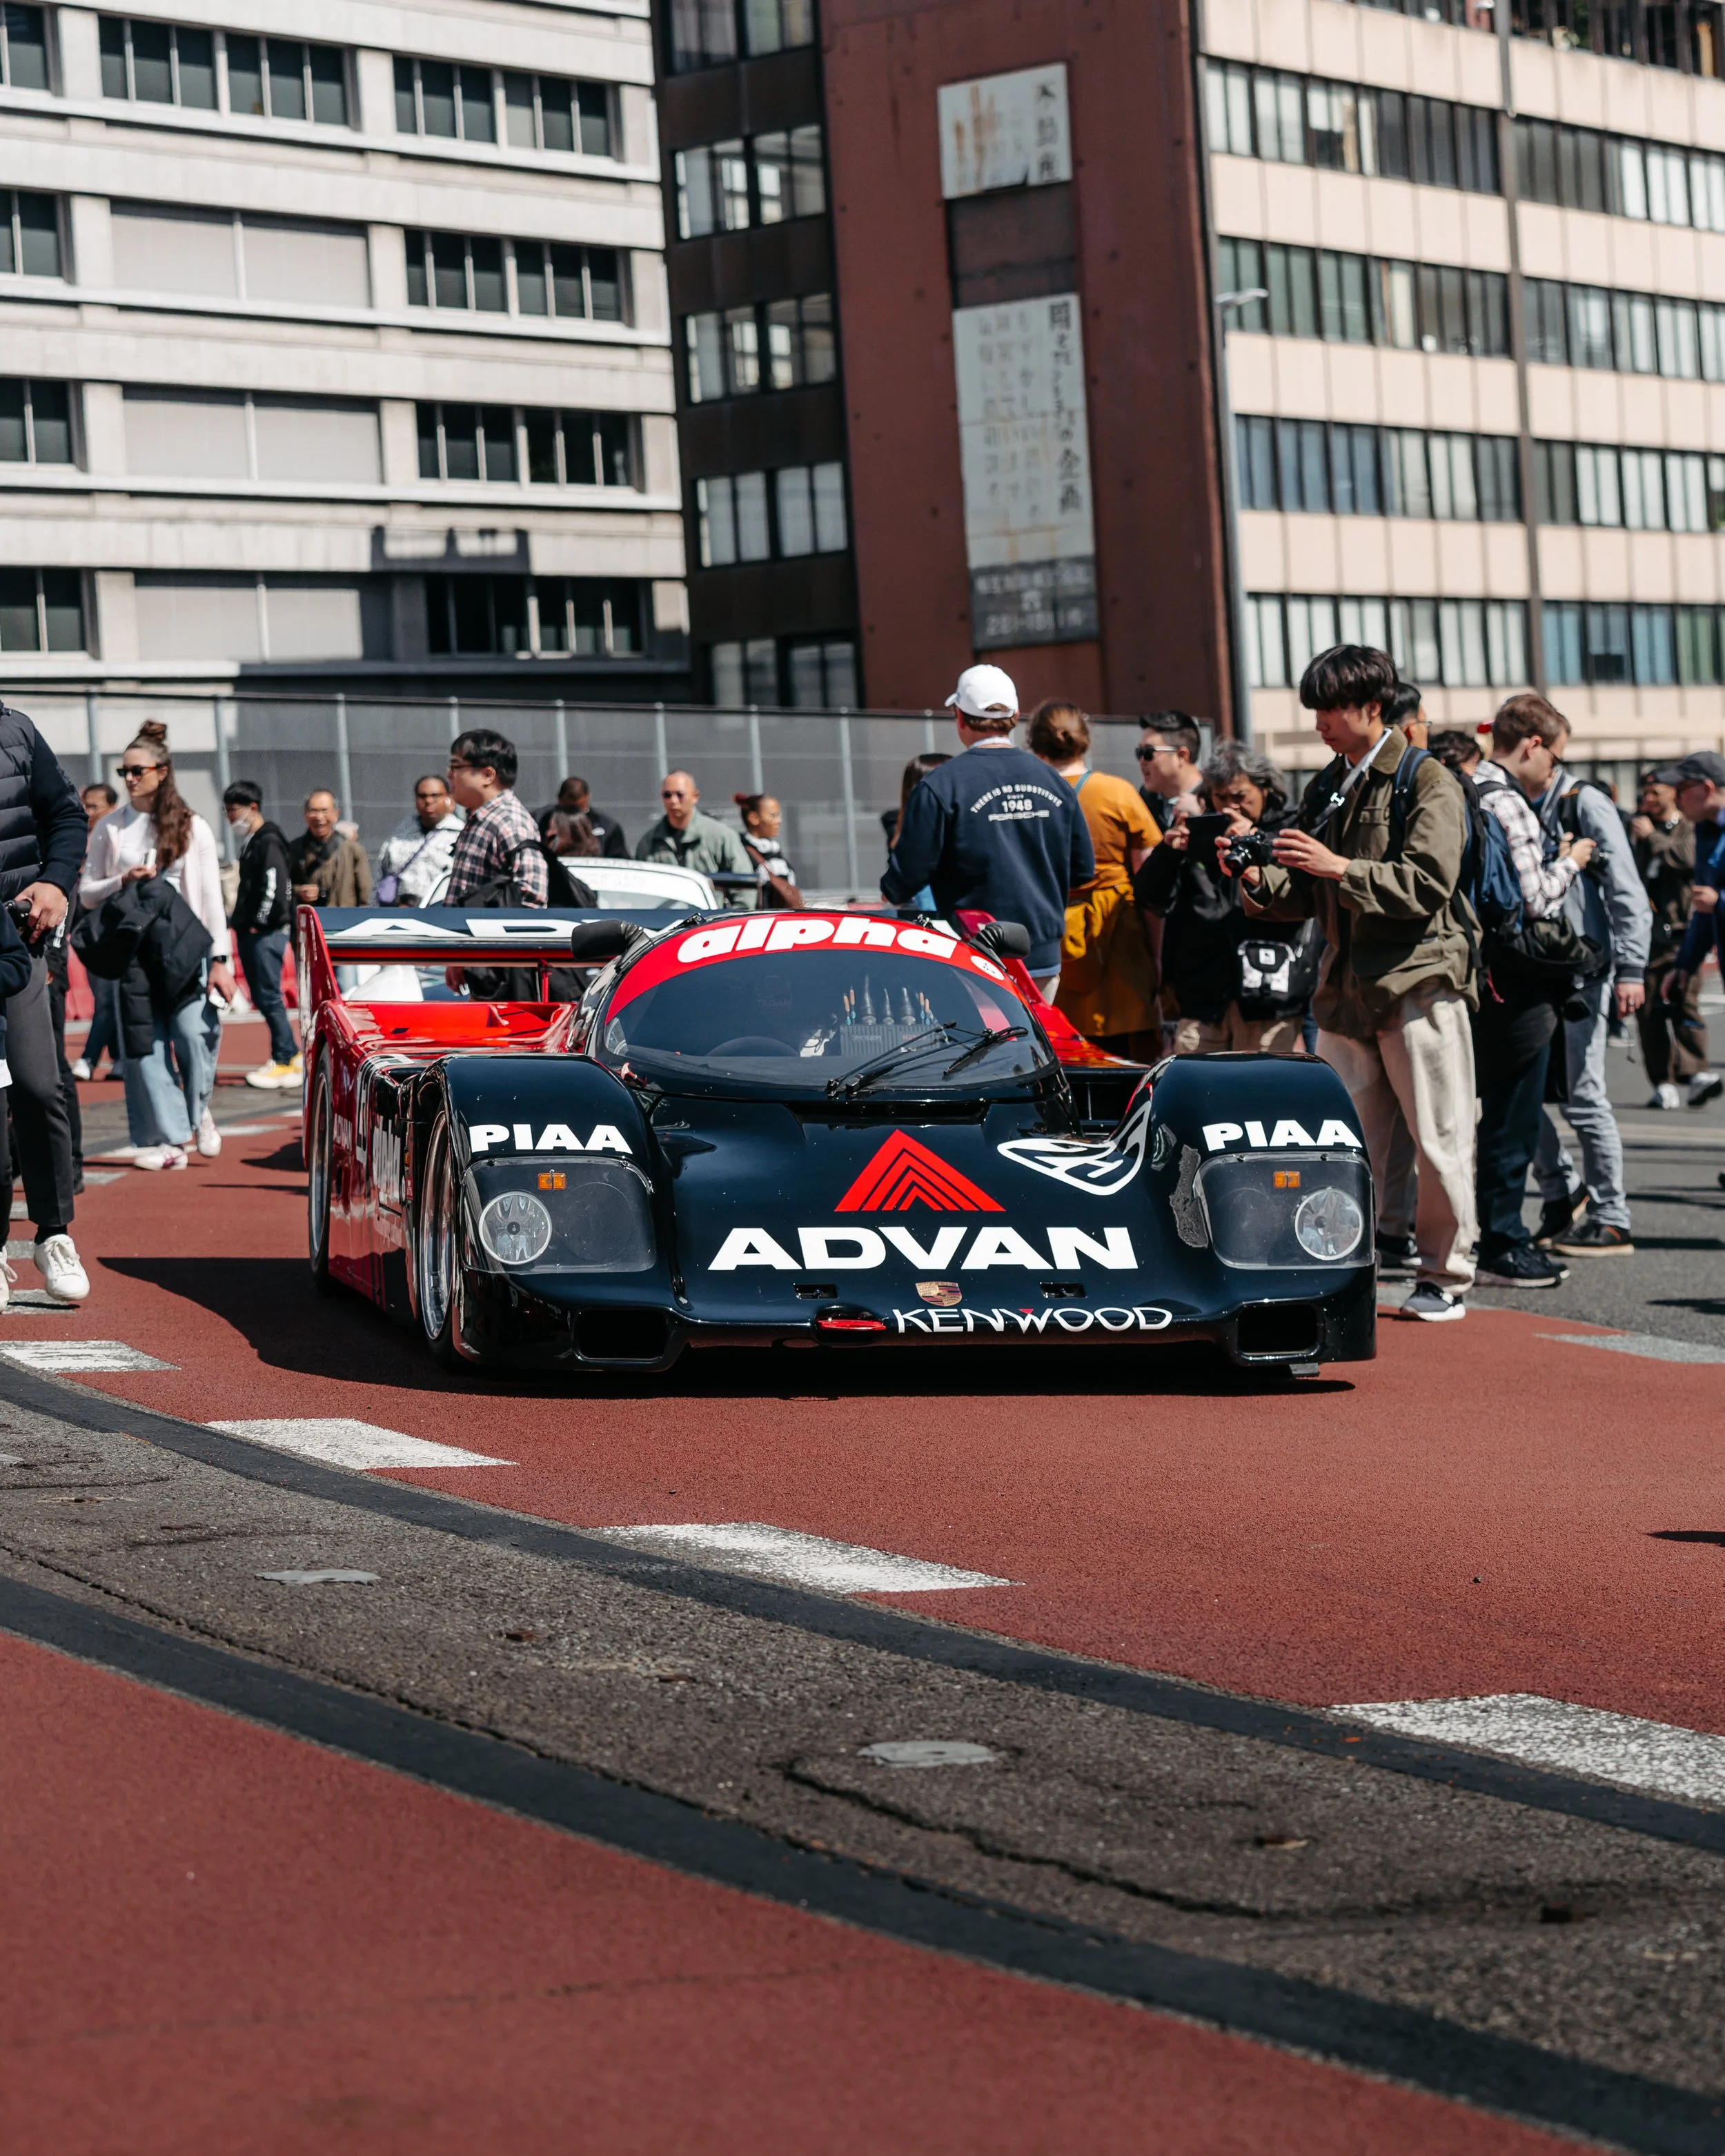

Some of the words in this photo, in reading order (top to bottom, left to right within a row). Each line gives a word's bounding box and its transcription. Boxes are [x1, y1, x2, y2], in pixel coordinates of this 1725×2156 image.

[970, 791, 994, 813] THERE
[992, 787, 1001, 796] IS
[1002, 784, 1012, 793] NO
[1014, 784, 1063, 807] SUBSTITUTE
[1001, 799, 1032, 812] 1948
[988, 810, 1049, 822] PORSCHE
[678, 917, 957, 963] alpha
[469, 1124, 633, 1154] PIAA
[1202, 1120, 1363, 1151] PIAA
[708, 1227, 1138, 1270] ADVAN
[896, 1307, 1173, 1334] KENWOOD
